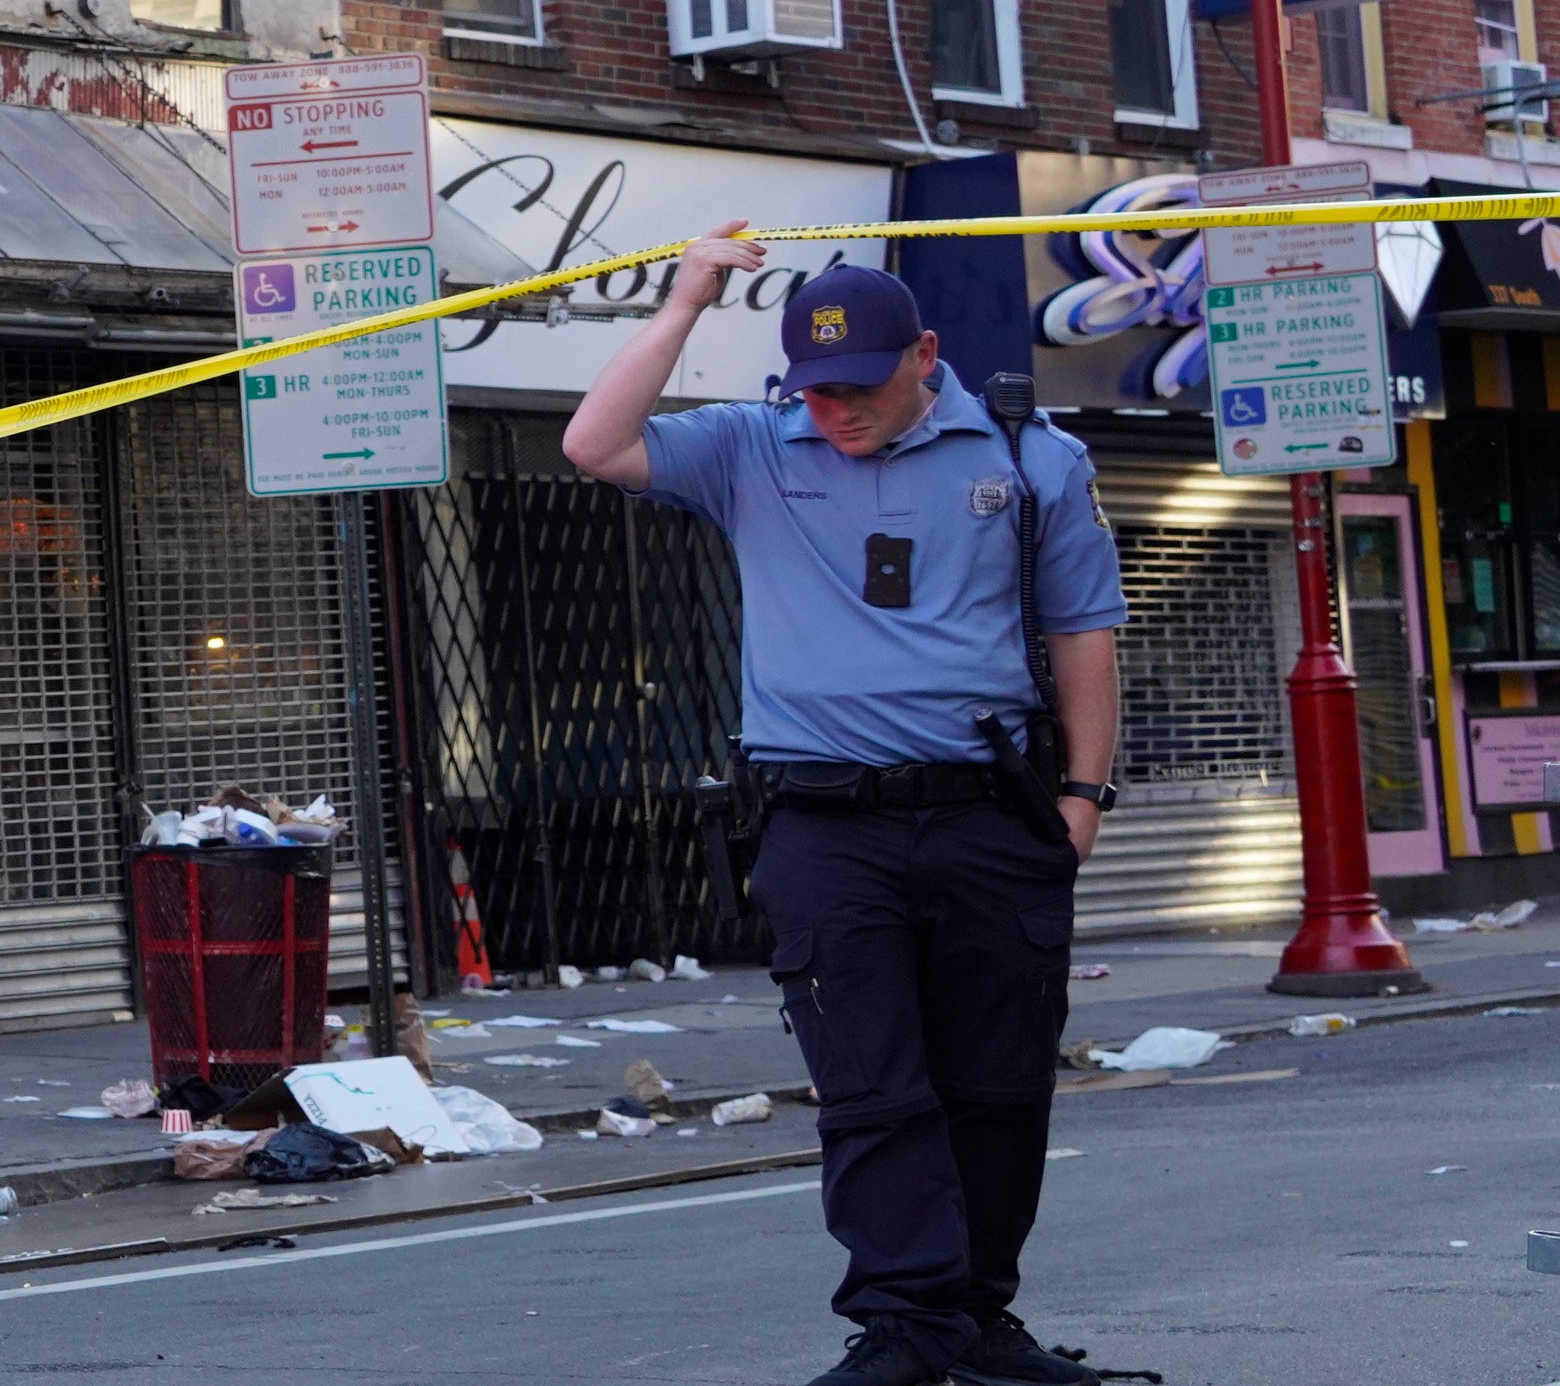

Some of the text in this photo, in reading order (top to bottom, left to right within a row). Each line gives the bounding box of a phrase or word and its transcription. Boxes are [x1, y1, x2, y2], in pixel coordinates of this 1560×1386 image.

[233, 72, 259, 83] TOW
[262, 69, 295, 80] AWAY
[300, 66, 329, 77] ZONE
[236, 100, 385, 130] NO STOPPING
[302, 124, 352, 138] ANY TIME
[257, 172, 299, 184] FRI-SUN
[259, 189, 283, 201] MON
[305, 256, 421, 285] RESERVED
[313, 285, 417, 312] PARKING
[1216, 278, 1353, 305] 2 HR PARKING
[814, 313, 844, 326] POLICE
[1220, 314, 1355, 340] 3 HR PARKING
[343, 347, 400, 360] MON-SUN
[255, 377, 267, 396] 3
[284, 374, 311, 393] HR
[1271, 377, 1371, 401] RESERVED
[1279, 398, 1367, 420] PARKING
[351, 425, 401, 439] FRI-SUN
